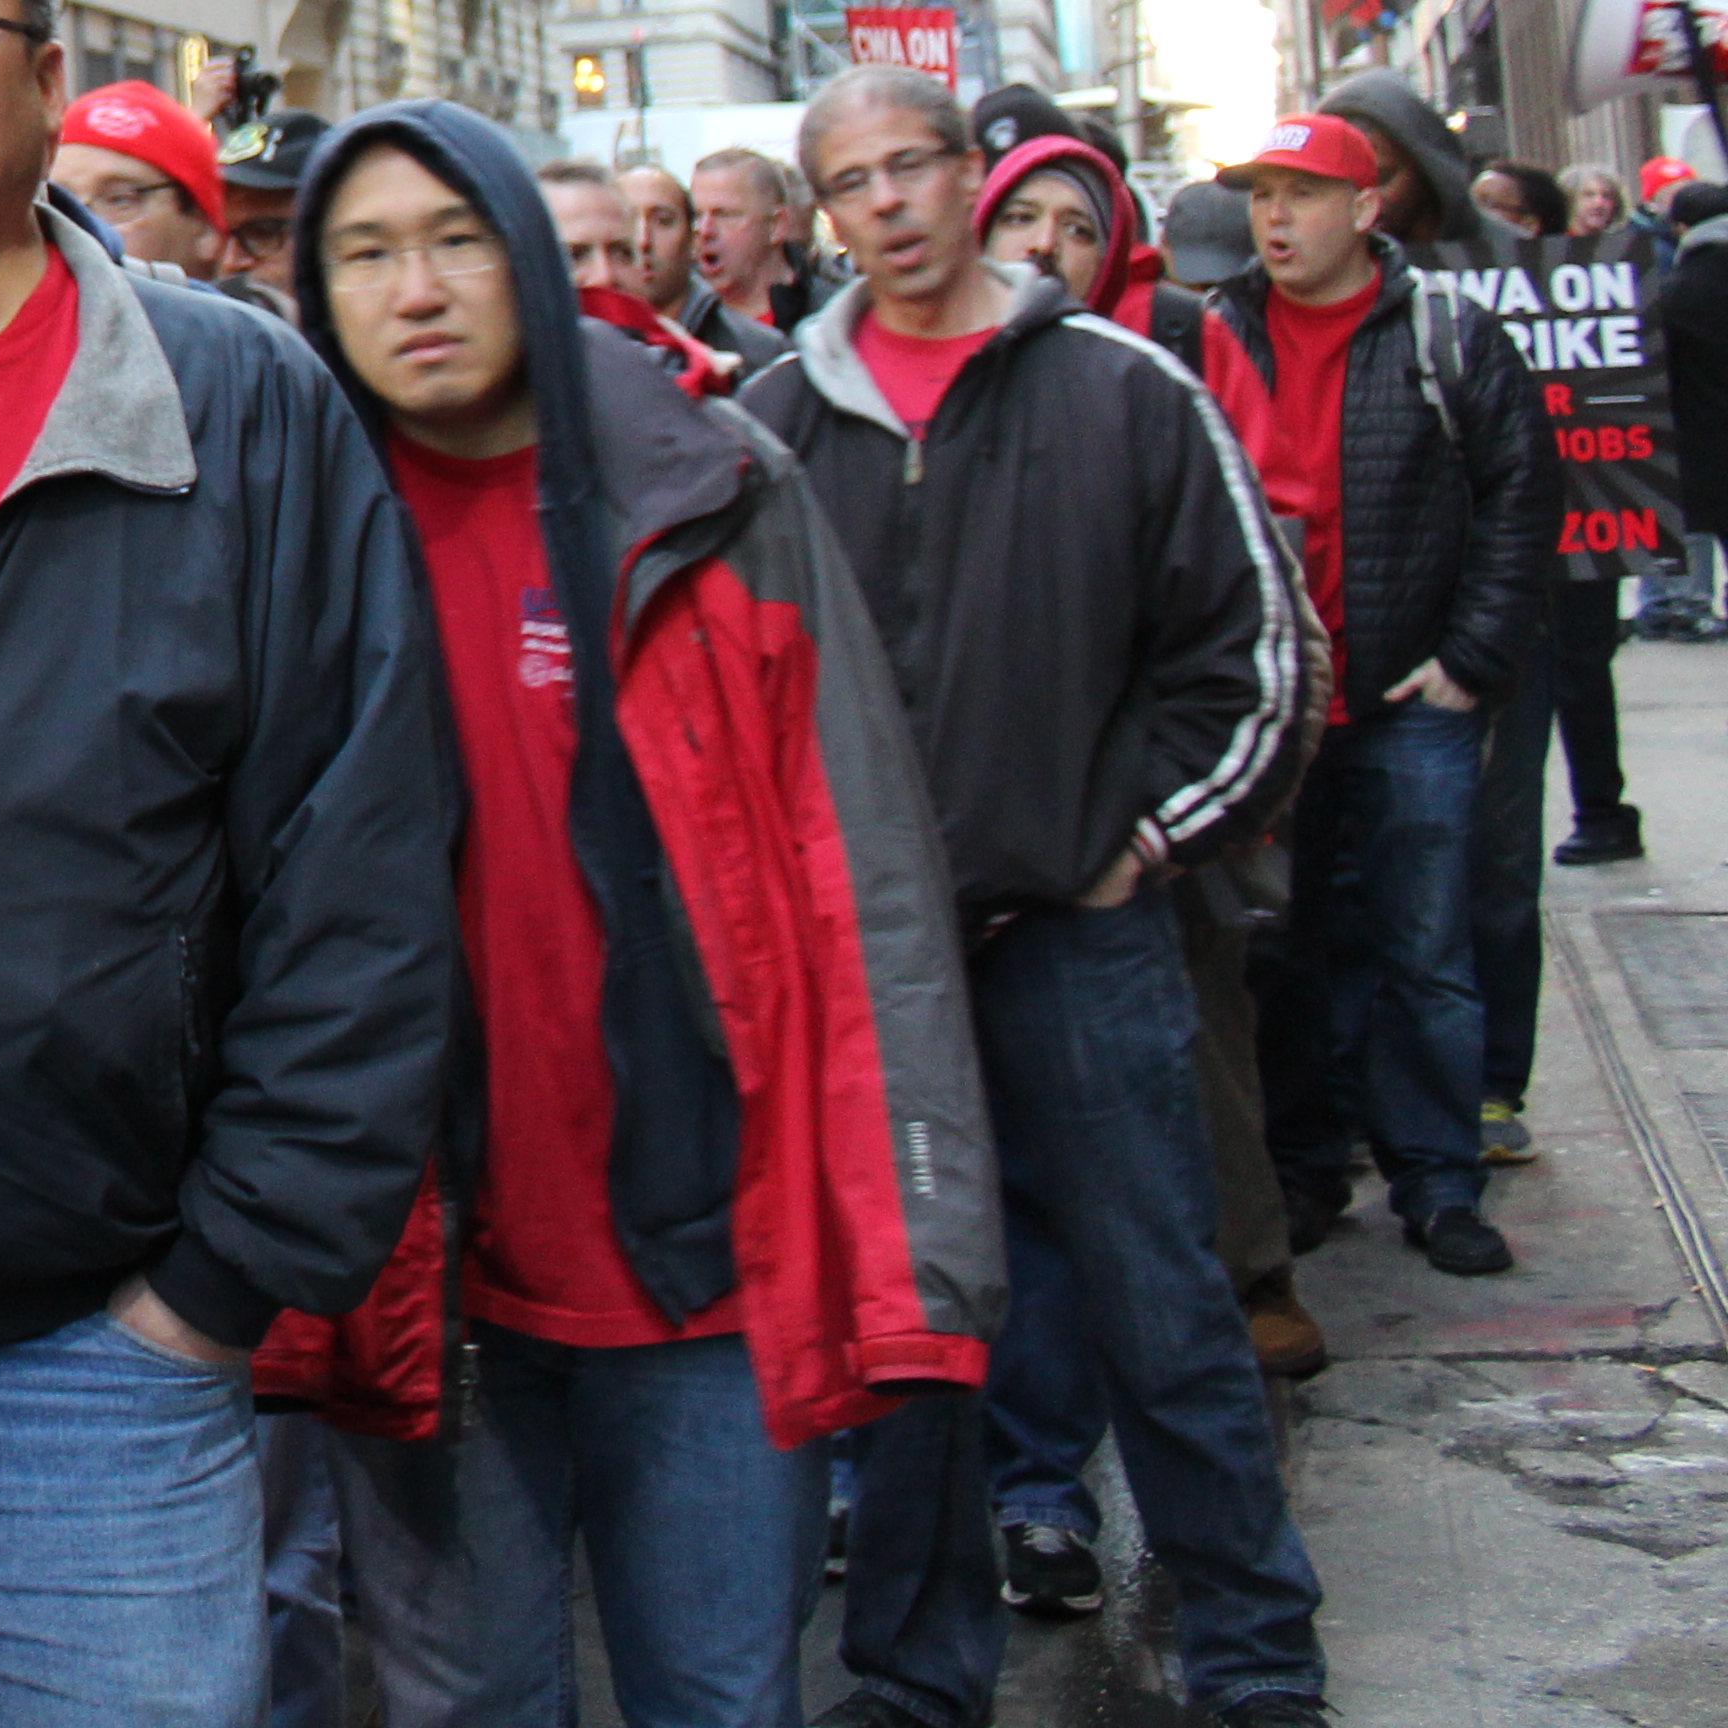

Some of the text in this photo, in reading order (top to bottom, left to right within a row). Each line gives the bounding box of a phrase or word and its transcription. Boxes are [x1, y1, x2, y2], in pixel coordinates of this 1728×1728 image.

[852, 26, 949, 68] CWA ON
[1549, 261, 1638, 313] ON
